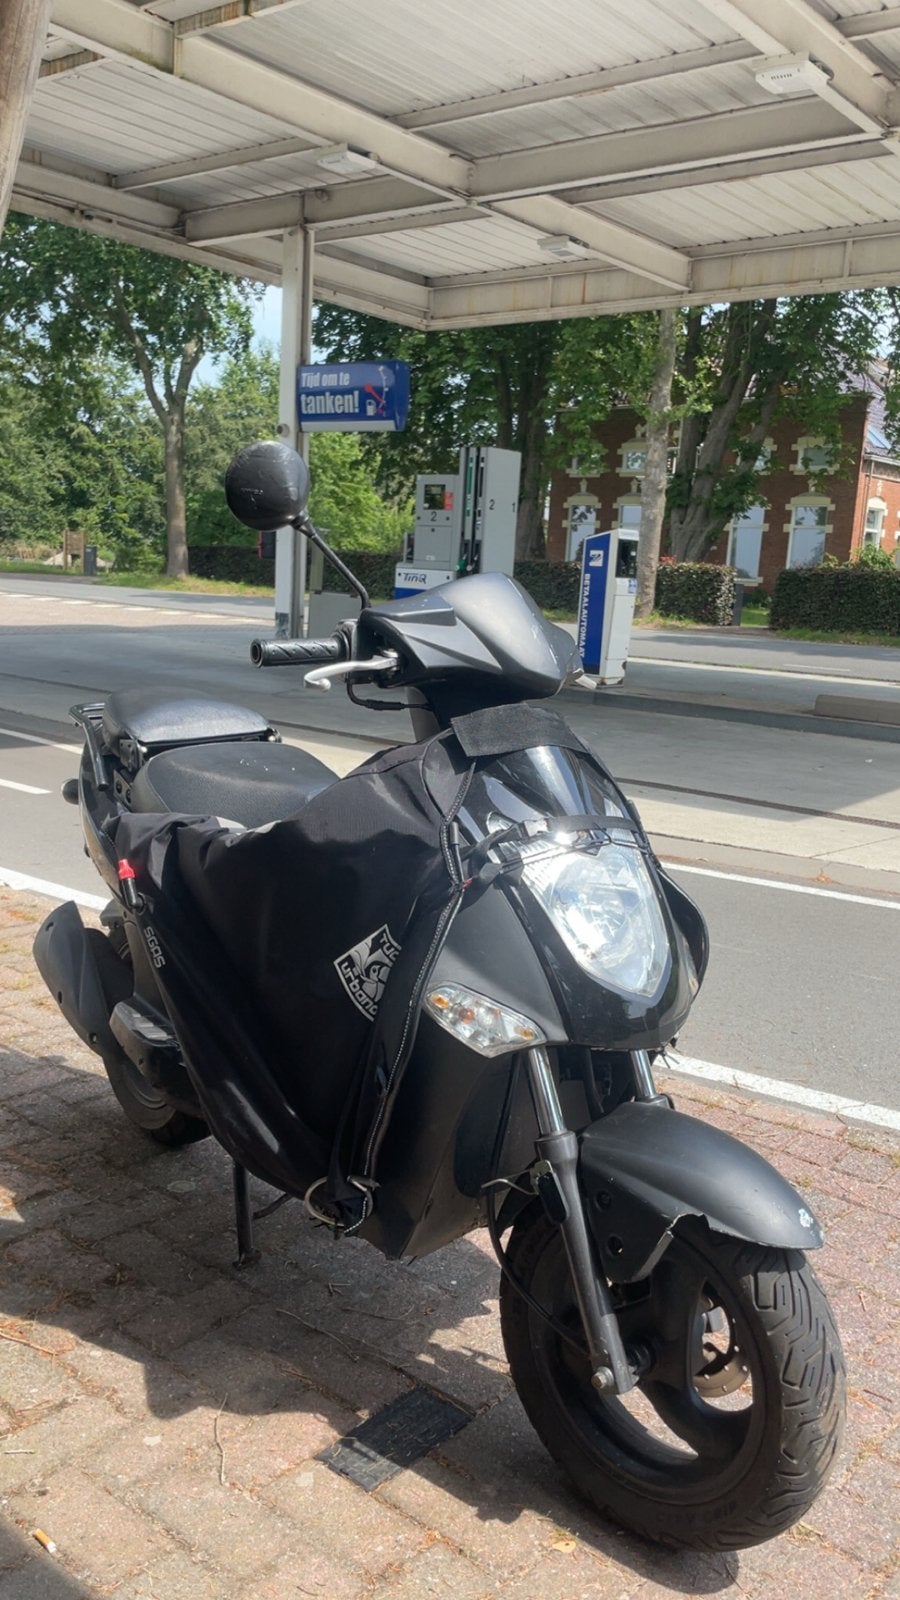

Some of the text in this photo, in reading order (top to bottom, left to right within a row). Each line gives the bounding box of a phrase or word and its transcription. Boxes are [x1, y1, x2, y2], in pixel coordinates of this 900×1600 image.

[301, 372, 350, 388] Tijd om te
[300, 390, 360, 415] tanken!
[489, 499, 496, 510] 2
[511, 502, 516, 513] 1
[430, 511, 437, 522] 2
[579, 573, 591, 658] BETAALAUTOMAAT
